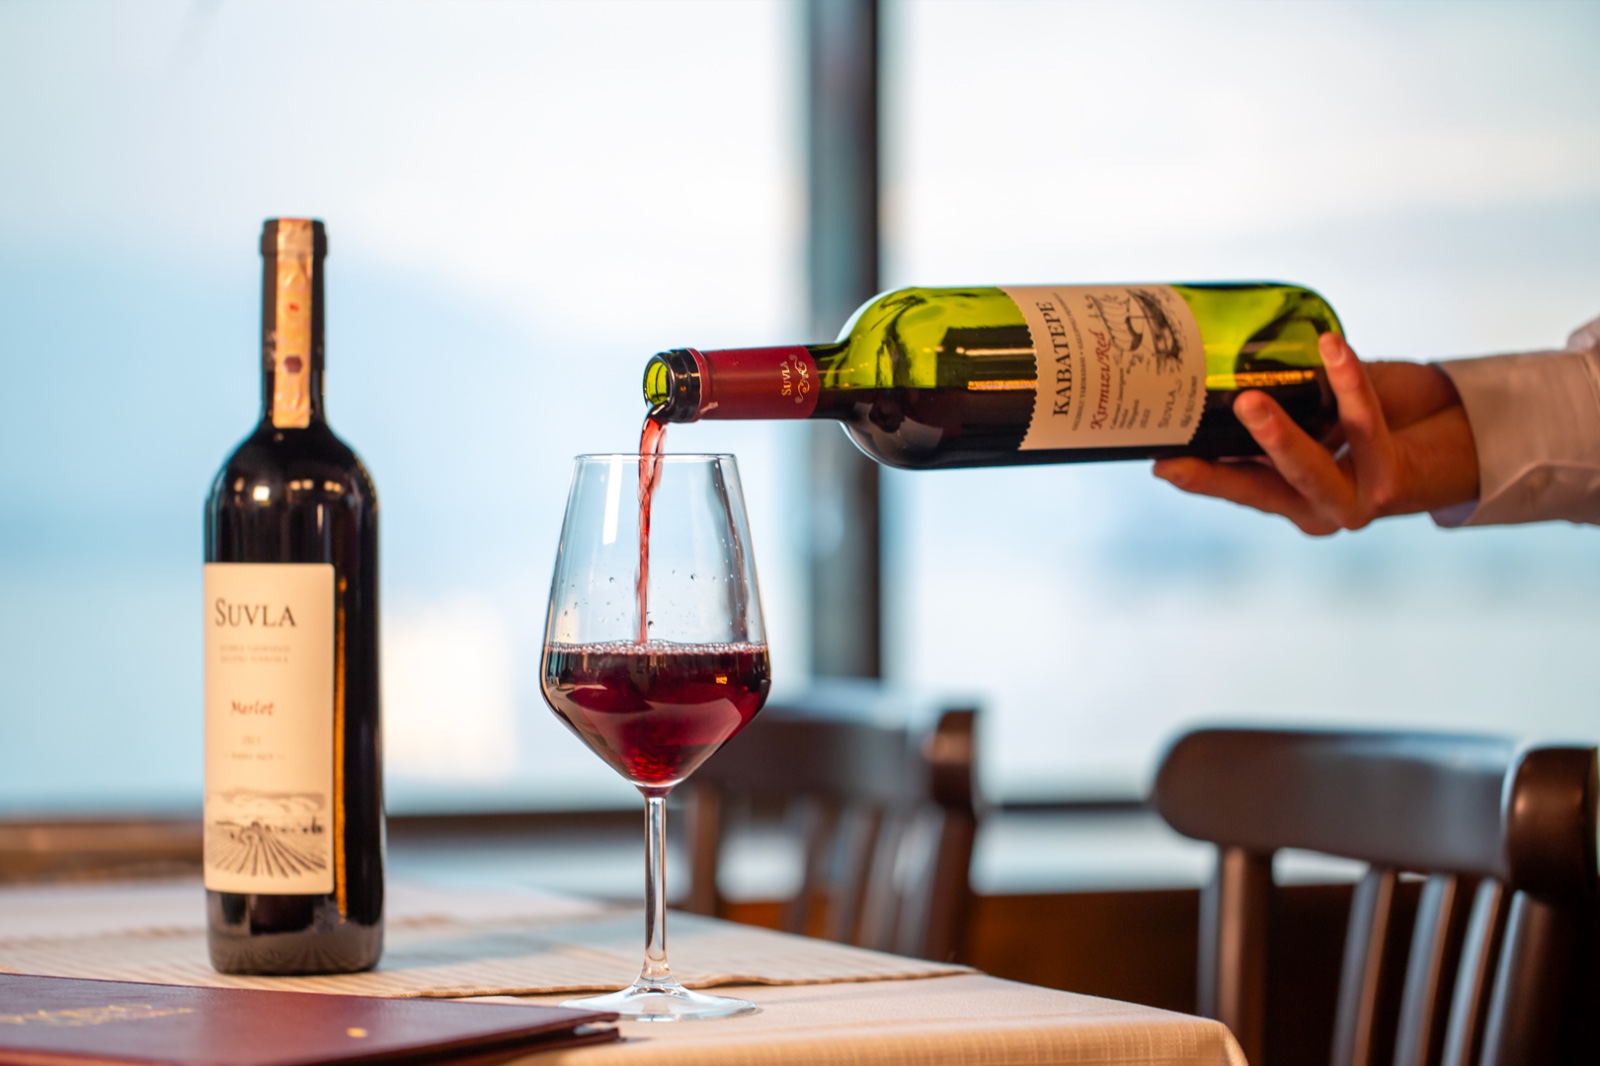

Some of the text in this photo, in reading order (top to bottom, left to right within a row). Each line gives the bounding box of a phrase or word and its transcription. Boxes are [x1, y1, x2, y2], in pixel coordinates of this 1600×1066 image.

[1036, 302, 1072, 416] KABATEPE
[779, 361, 792, 396] SUVLA
[1157, 390, 1176, 429] SUVLA
[215, 597, 297, 628] SUVLA
[230, 700, 275, 717] Merlot
